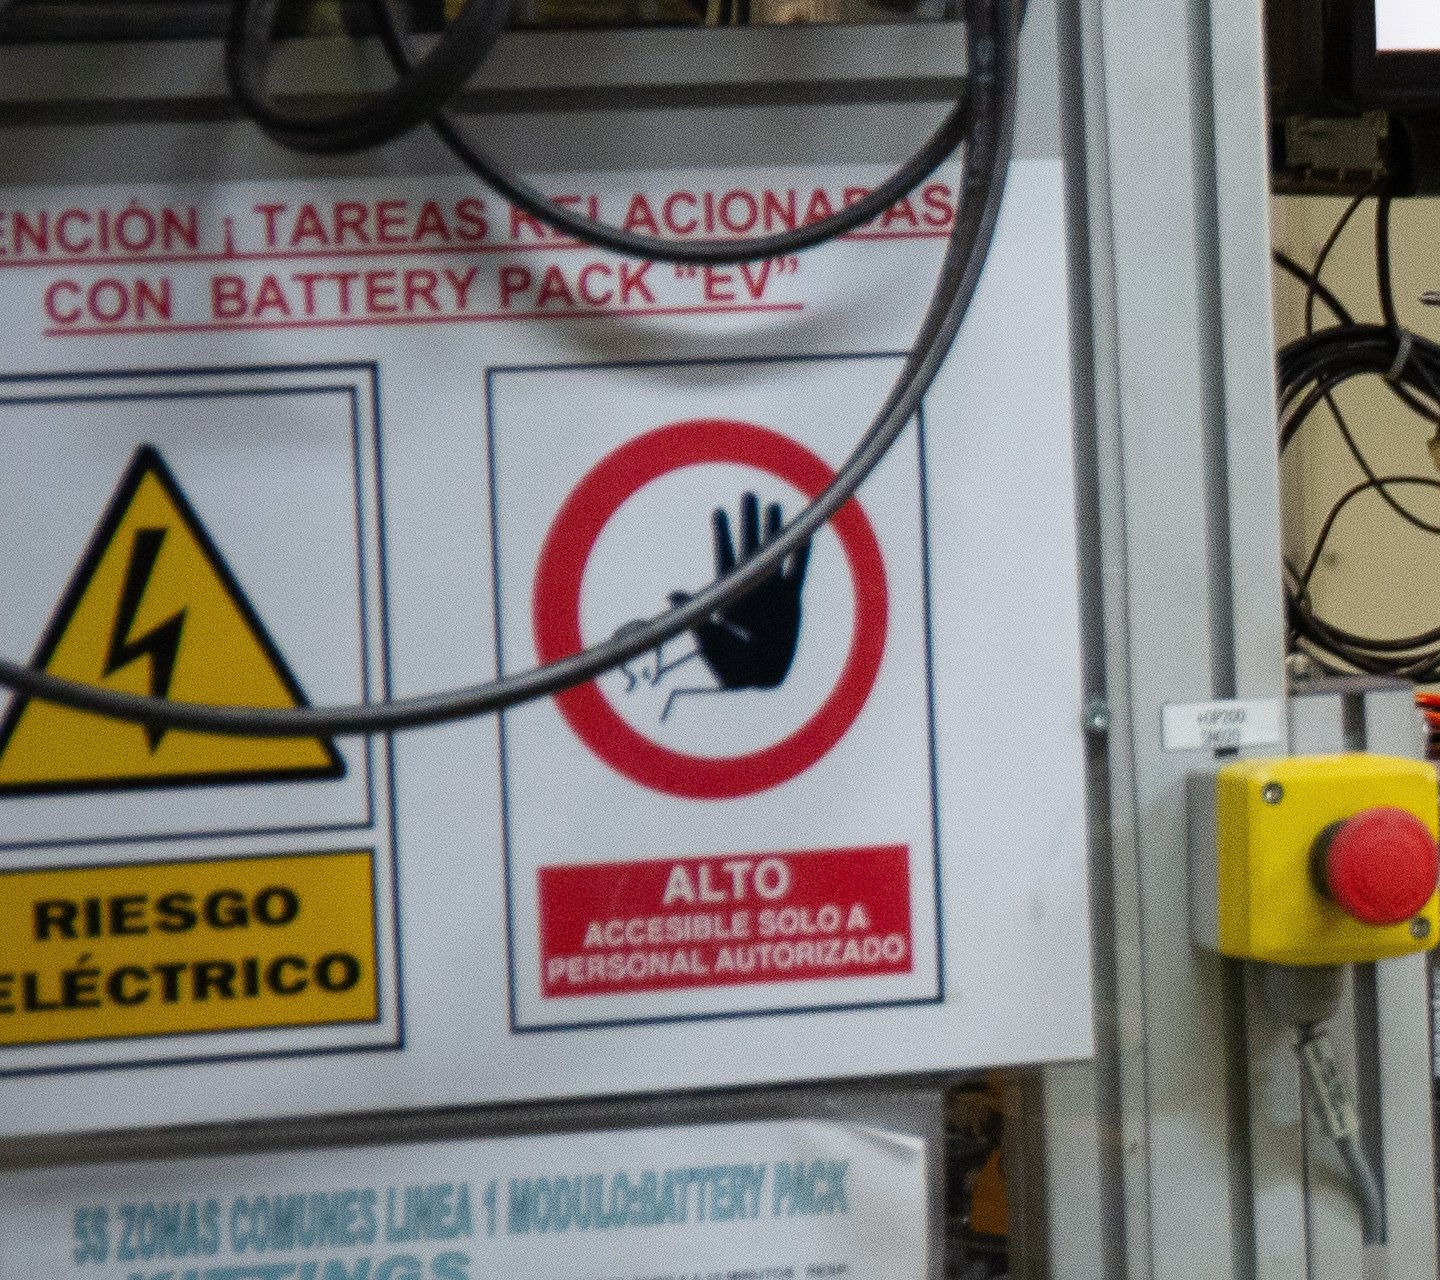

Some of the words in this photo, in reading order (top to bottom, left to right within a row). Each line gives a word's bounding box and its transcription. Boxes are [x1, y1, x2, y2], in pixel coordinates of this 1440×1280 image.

[0, 198, 199, 256] NCIÓN
[253, 198, 489, 248] TAREAS
[44, 277, 172, 323] CON
[211, 266, 478, 318] BATTERY
[499, 260, 657, 308] PACK
[663, 857, 794, 906] ALTO
[33, 885, 303, 943] RIESGO
[583, 911, 751, 948] ACCESIBLE
[759, 906, 839, 937] SOLO
[844, 906, 867, 931] A
[547, 939, 713, 985] PERSONAL
[716, 931, 906, 974] AUTORIZADO
[73, 1204, 109, 1266] 5S
[116, 1198, 222, 1262] ZONAS
[229, 1186, 378, 1254] COMUNES
[386, 1180, 475, 1244] LINEA
[483, 1178, 498, 1236] 1
[774, 1159, 851, 1219] PACK
